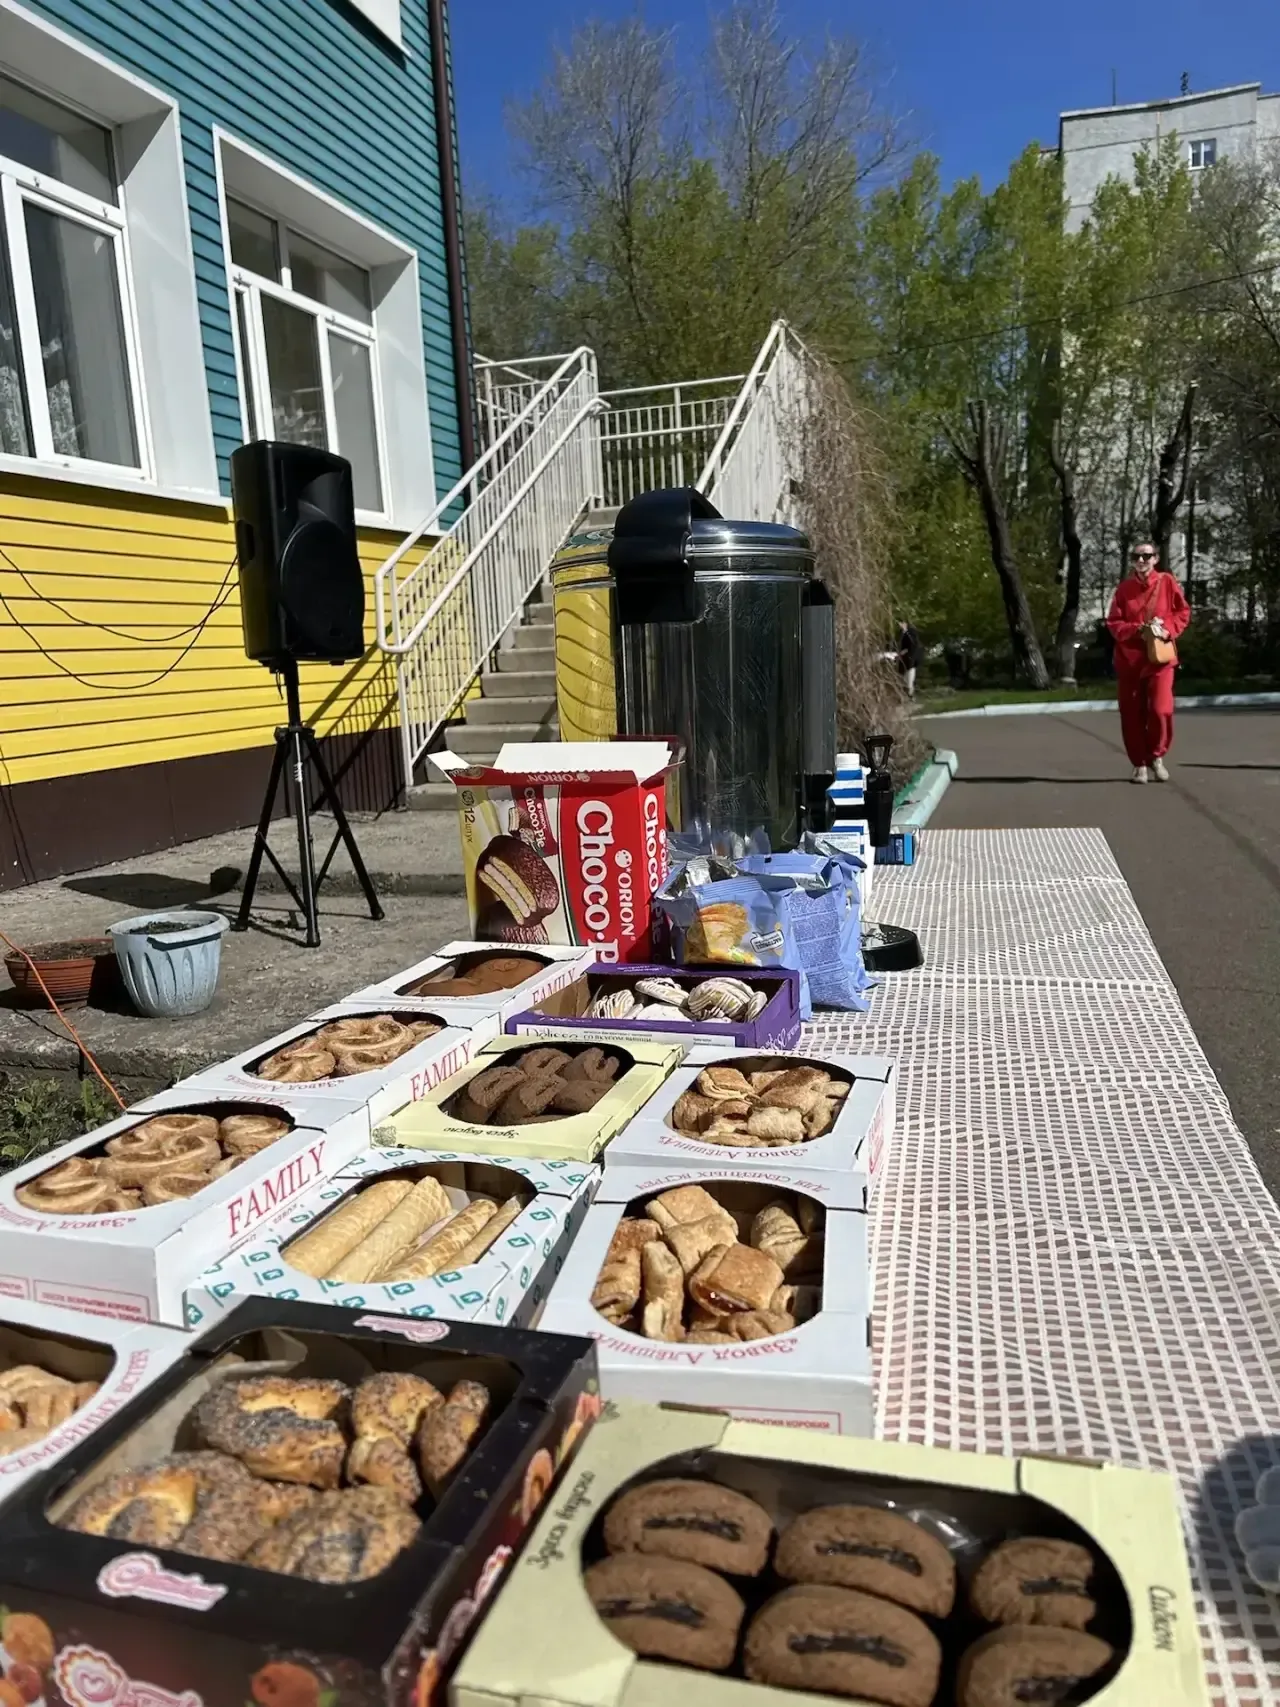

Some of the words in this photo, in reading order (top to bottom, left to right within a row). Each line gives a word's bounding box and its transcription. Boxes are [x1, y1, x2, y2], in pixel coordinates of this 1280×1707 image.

[465, 808, 476, 823] 12
[643, 793, 659, 893] Choco
[617, 871, 635, 937] ORION
[532, 968, 577, 1007] FAMILY
[410, 1038, 473, 1102] FAMILY
[226, 1140, 327, 1239] FAMILY
